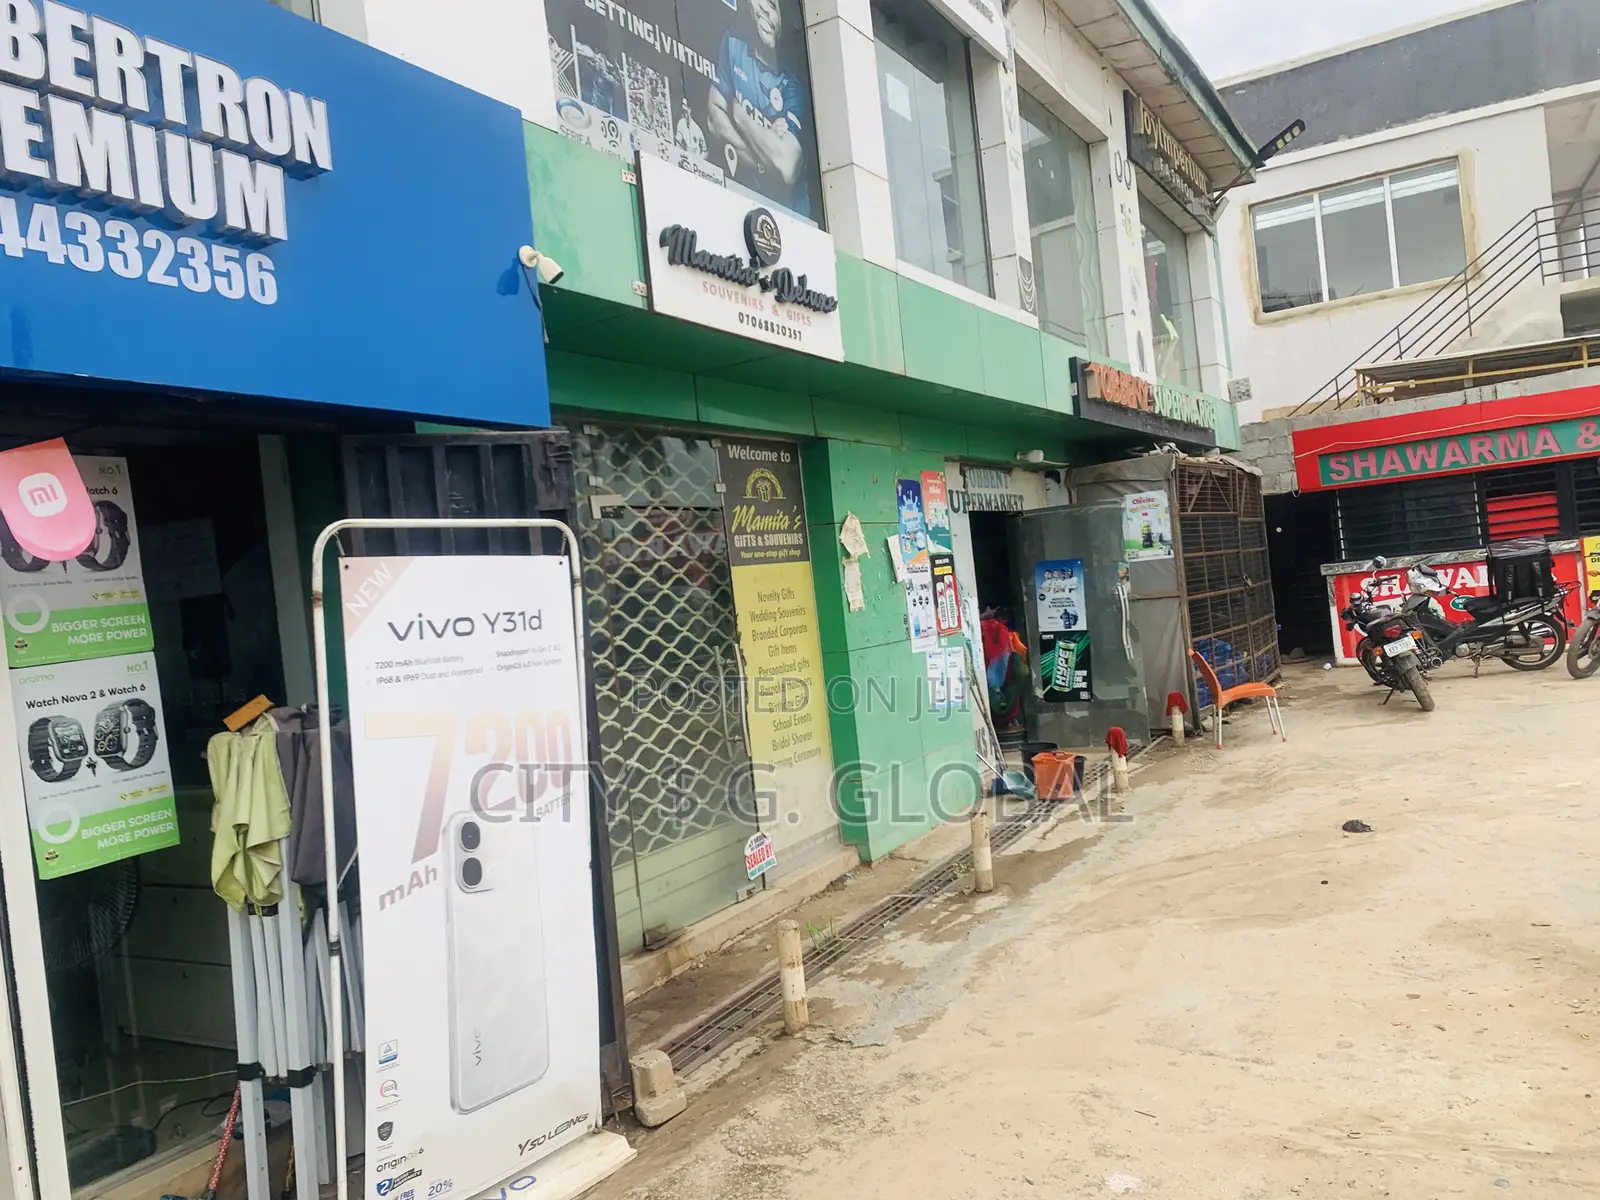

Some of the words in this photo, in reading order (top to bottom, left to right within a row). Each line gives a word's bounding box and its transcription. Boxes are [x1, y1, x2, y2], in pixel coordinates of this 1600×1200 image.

[660, 31, 720, 84] VIRTUAL
[0, 0, 332, 171] BERTRON
[0, 82, 288, 241] EMIUM
[702, 281, 764, 312] SOUVENIRS
[771, 267, 838, 313] Deluxe
[728, 444, 777, 461] Welcome
[780, 450, 791, 462] to
[1329, 427, 1562, 481] SHAWARMA
[86, 487, 110, 496] atch
[112, 486, 119, 495] 6
[732, 504, 803, 533] Mamita's
[734, 534, 757, 548] GIFTS
[758, 535, 763, 546] &
[764, 533, 803, 546] SOUVENIRS
[741, 551, 753, 559] Your
[754, 550, 778, 559] one-stop
[778, 550, 788, 558] gift
[789, 549, 801, 557] shop
[345, 561, 393, 618] NEW
[757, 590, 780, 603] Novelty
[781, 588, 795, 600] Gifts
[51, 621, 98, 633] BIGGER
[100, 614, 146, 628] SCREEN
[749, 610, 777, 623] Wedding
[778, 606, 806, 618] Souvenirs
[388, 613, 475, 641] vivo
[482, 609, 542, 634] Y31d
[751, 628, 778, 642] Branded
[779, 623, 807, 639] Corporate
[68, 632, 104, 645] MORE
[107, 628, 147, 641] POWER
[768, 645, 780, 657] Gift
[780, 644, 797, 655] Items
[19, 673, 54, 684] oraimo
[126, 660, 149, 673] NO.1
[375, 660, 393, 669] 7200
[395, 659, 413, 669] mAh
[758, 662, 797, 678] Personalized
[797, 659, 810, 672] gifts
[1055, 649, 1069, 687] HYPE
[376, 676, 393, 685] IP68
[395, 675, 401, 683] &
[403, 673, 420, 682] IP69
[421, 671, 436, 680] Dust
[25, 696, 59, 709] Watch
[61, 693, 88, 704] Nova
[90, 690, 96, 699] 2
[99, 690, 105, 698] &
[108, 684, 138, 696] Watch
[140, 683, 146, 691] 6
[772, 716, 792, 732] School
[794, 712, 812, 727] Events
[772, 737, 790, 752] Bridal
[792, 731, 813, 746] Shower
[793, 746, 821, 764] Ceremony
[366, 710, 573, 860] 7200
[81, 820, 126, 840] BIGGER
[128, 808, 172, 827] SCREEN
[97, 832, 133, 850] MORE
[134, 822, 175, 840] POWER
[379, 865, 438, 911] mAh
[380, 1180, 390, 1195] 2
[428, 1179, 453, 1197] 20%
